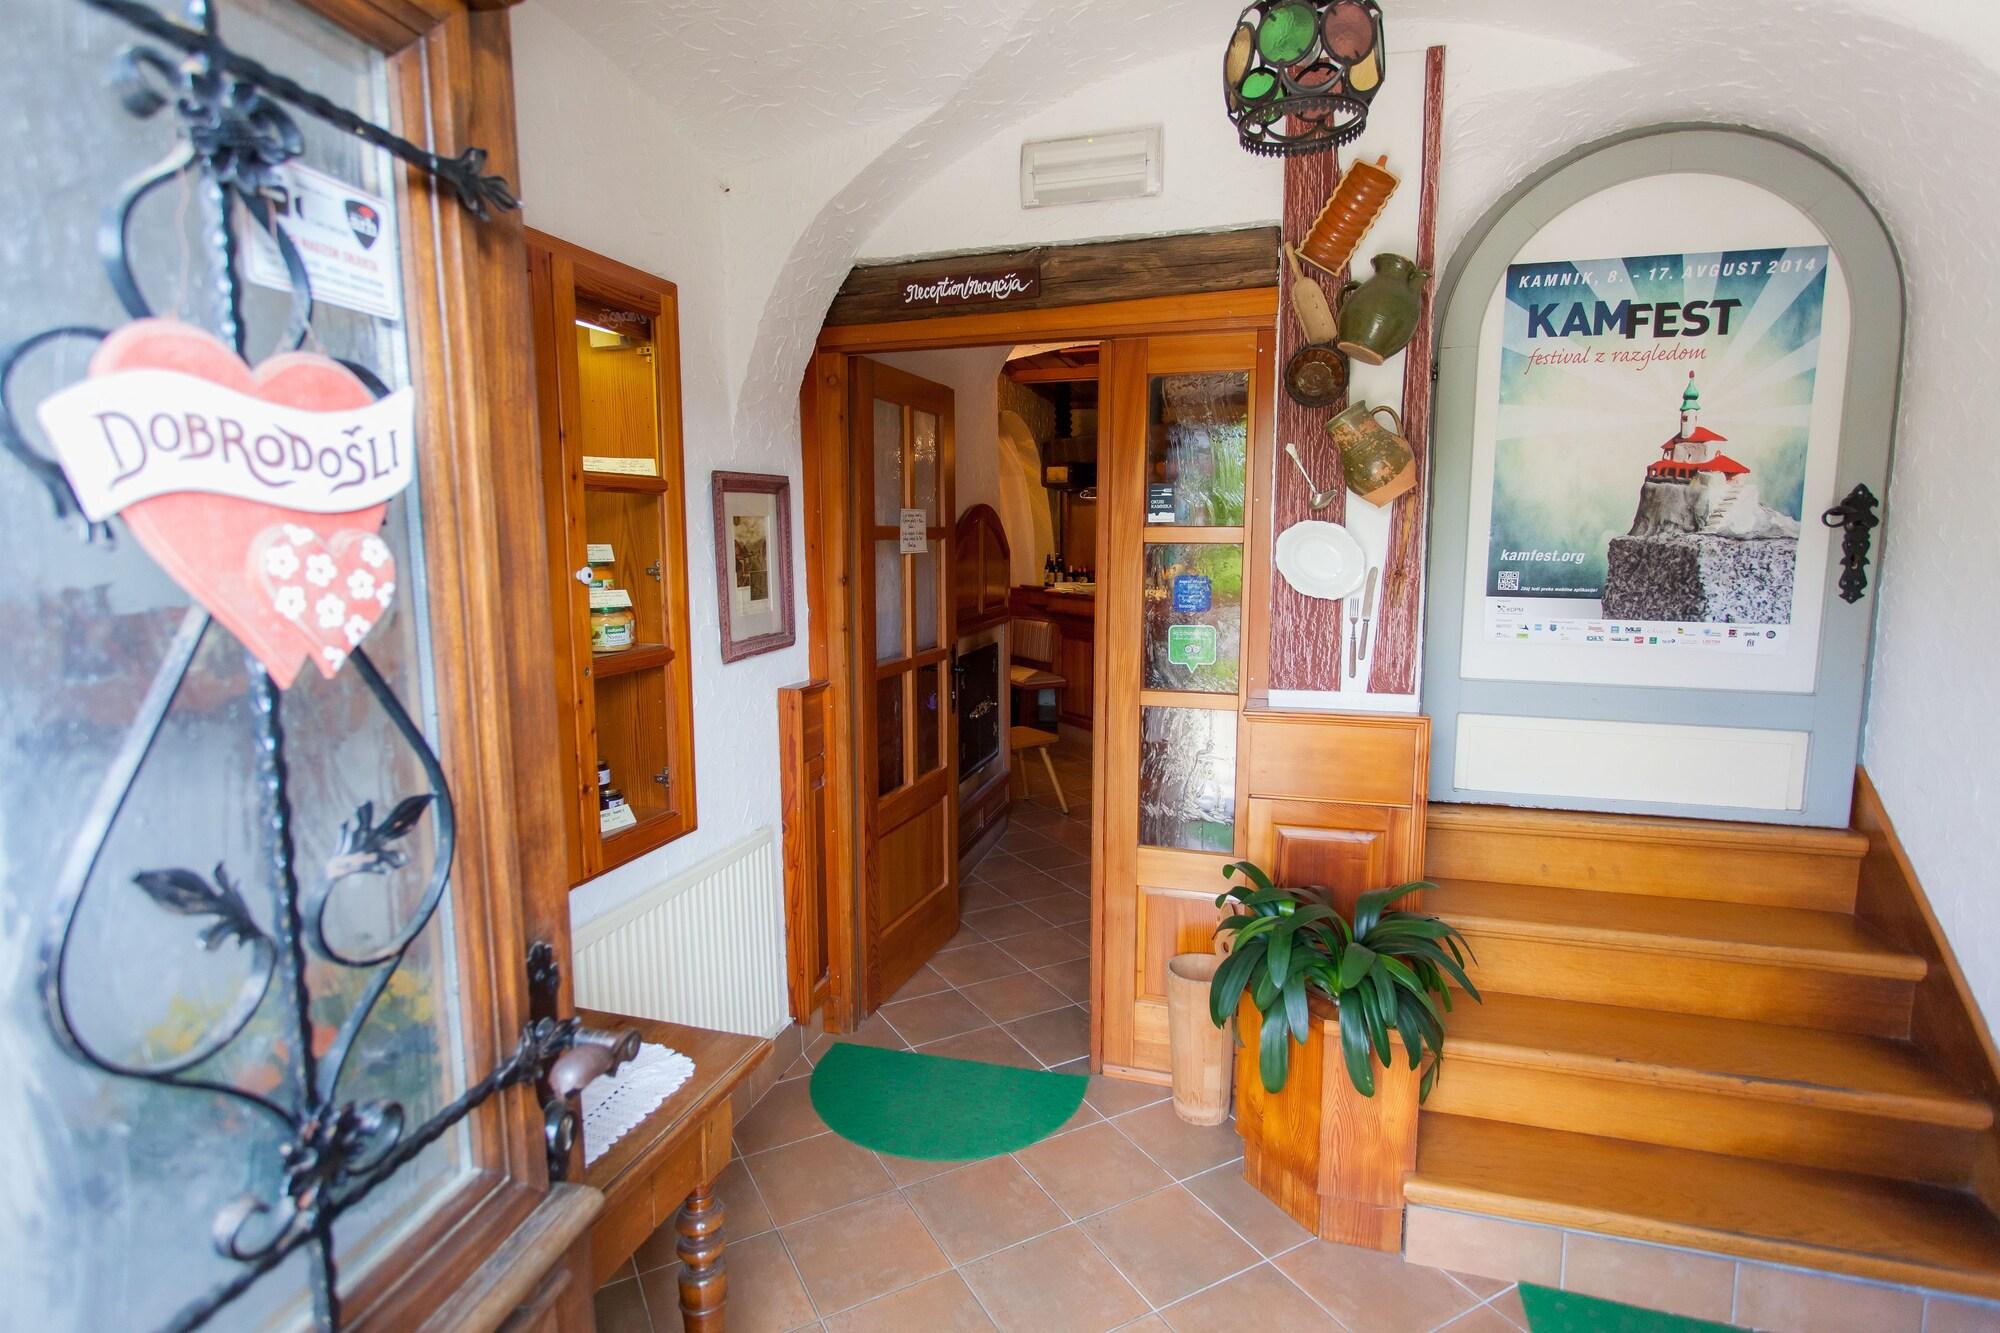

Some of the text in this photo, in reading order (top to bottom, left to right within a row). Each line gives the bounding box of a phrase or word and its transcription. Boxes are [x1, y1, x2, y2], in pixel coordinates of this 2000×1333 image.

[1518, 271, 1600, 289] KAMNIK,
[1607, 268, 1625, 284] 8.
[1648, 266, 1674, 282] 17.
[1682, 260, 1762, 281] AVGUST
[1766, 258, 1817, 275] 2014
[1527, 298, 1742, 340] KAMFEST
[1524, 343, 1707, 375] festival z razgledom
[1500, 549, 1586, 564] kamfest.org
